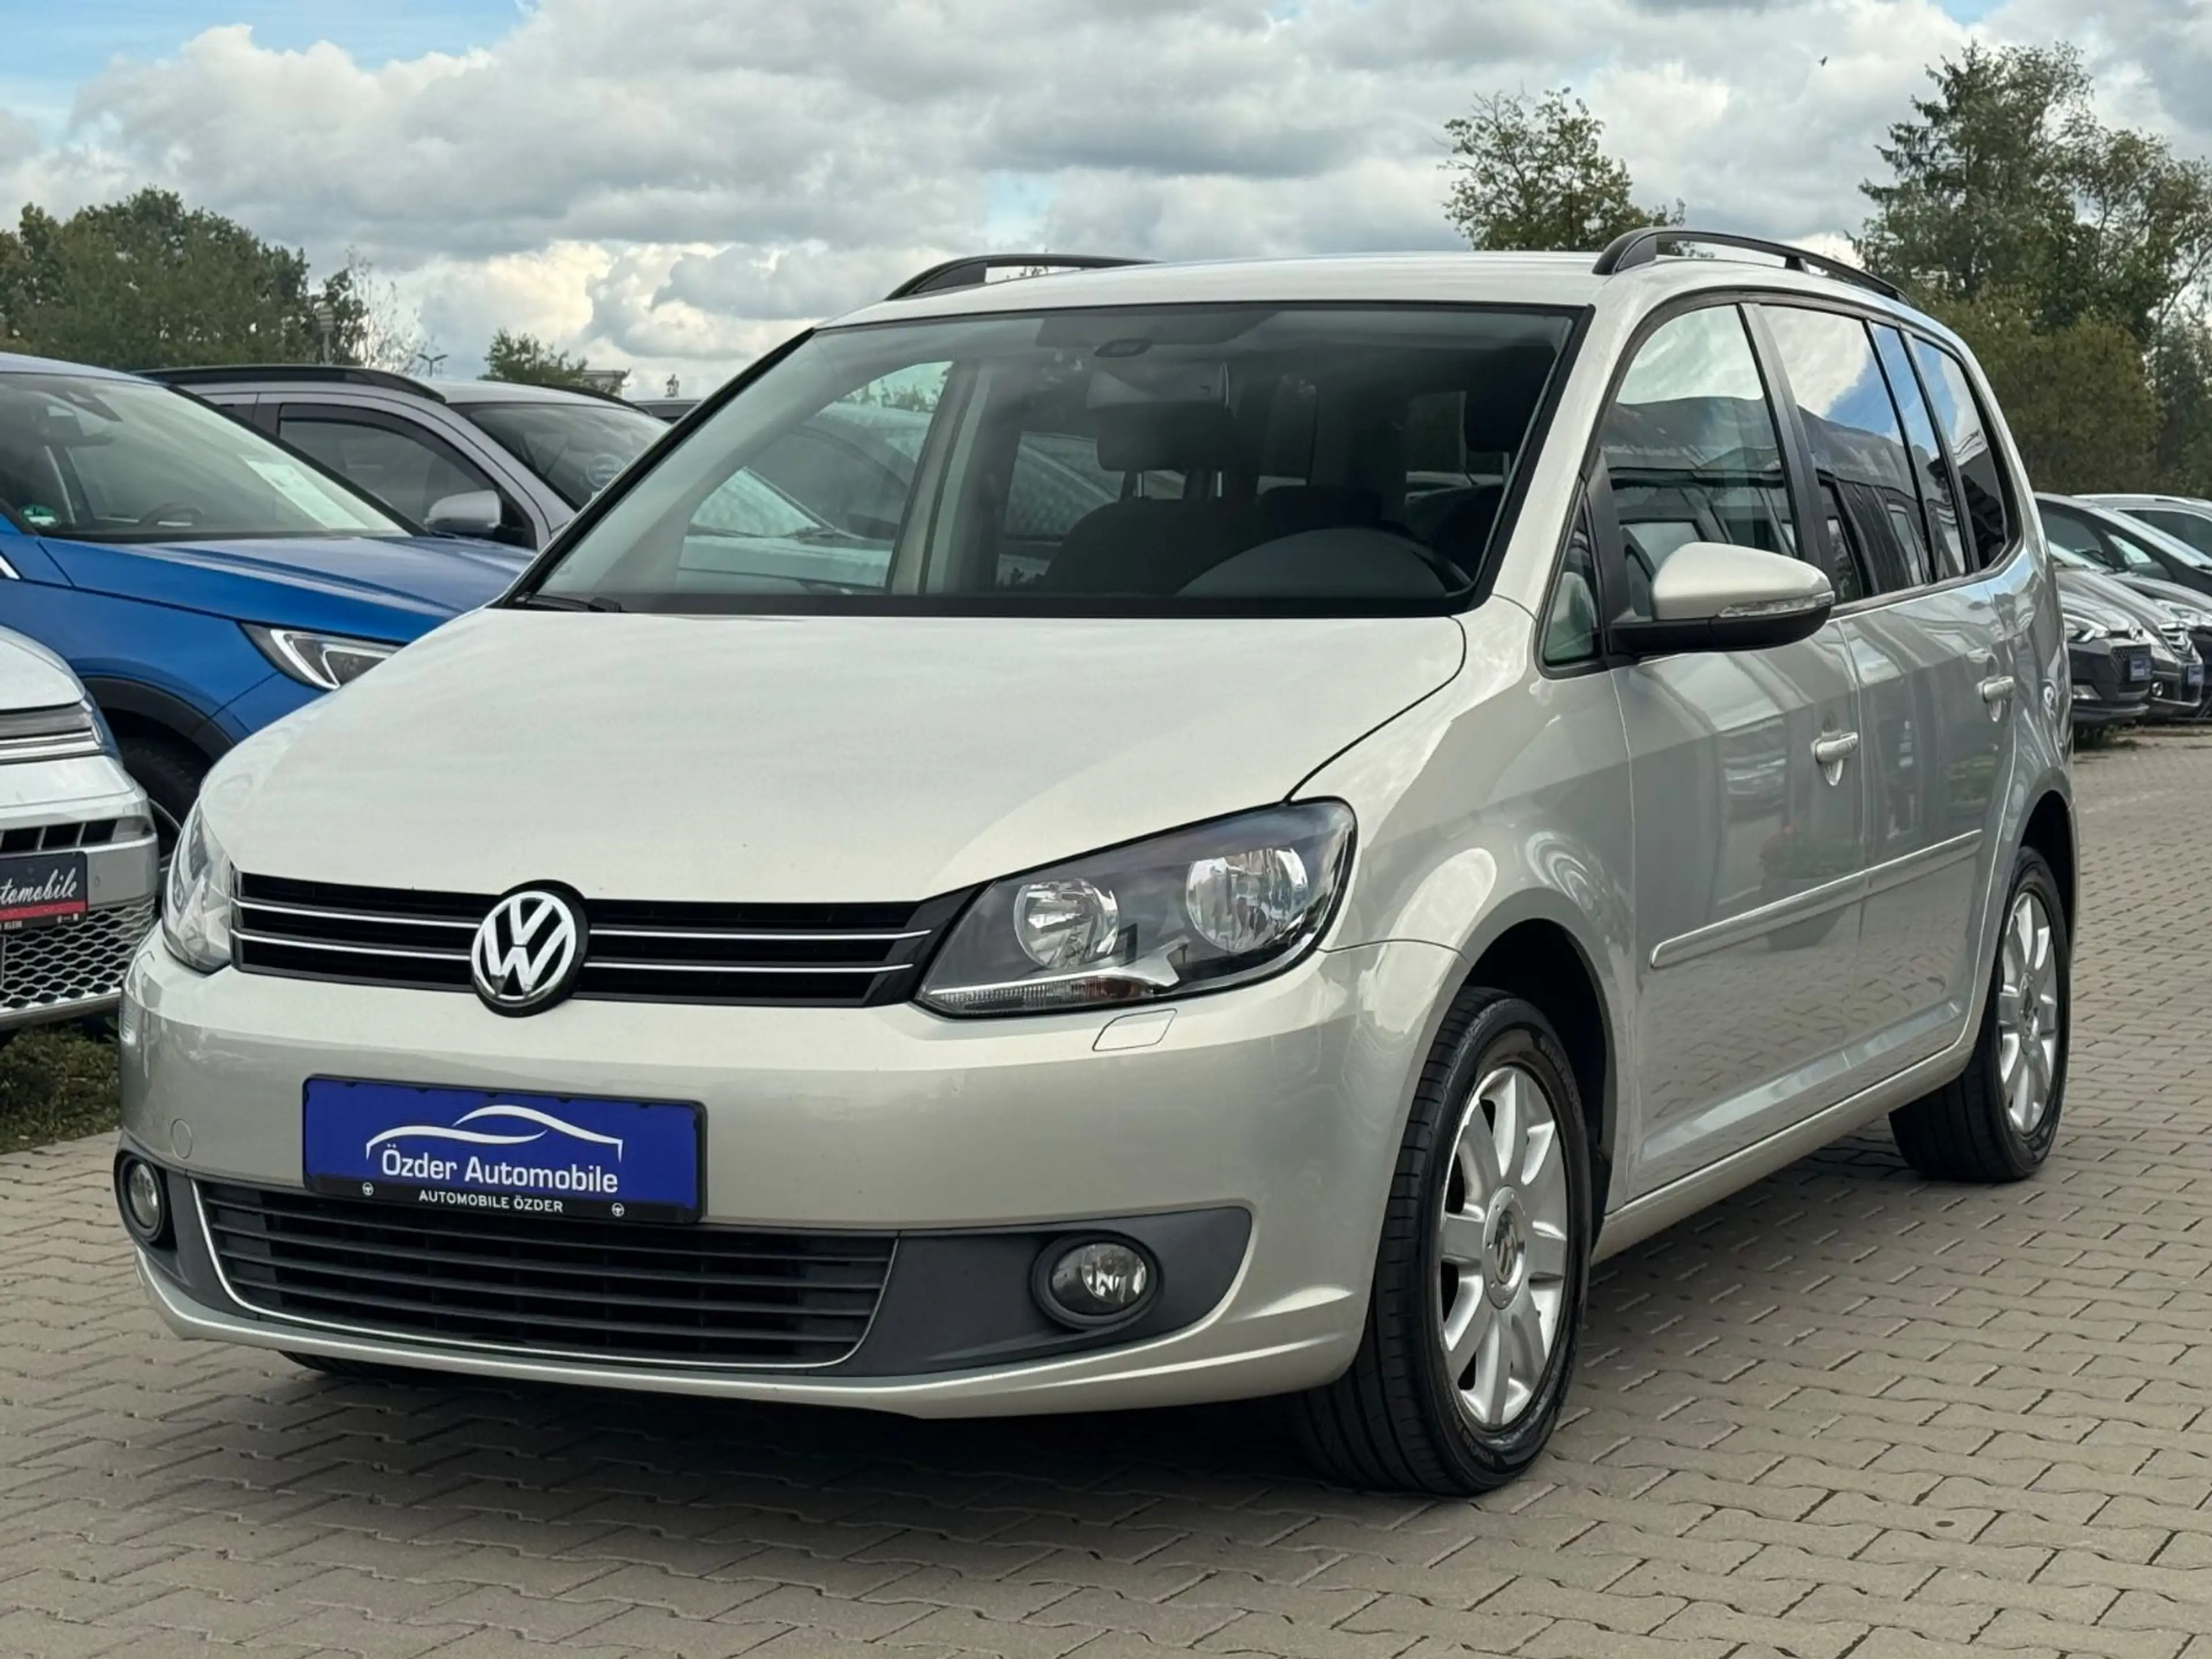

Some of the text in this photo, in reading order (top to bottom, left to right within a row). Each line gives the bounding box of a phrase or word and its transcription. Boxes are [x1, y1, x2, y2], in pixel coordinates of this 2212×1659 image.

[474, 891, 575, 1002] VW
[382, 1143, 618, 1193] Özder Automobile
[419, 1189, 563, 1212] AUTOMOBILE ÖZDER
